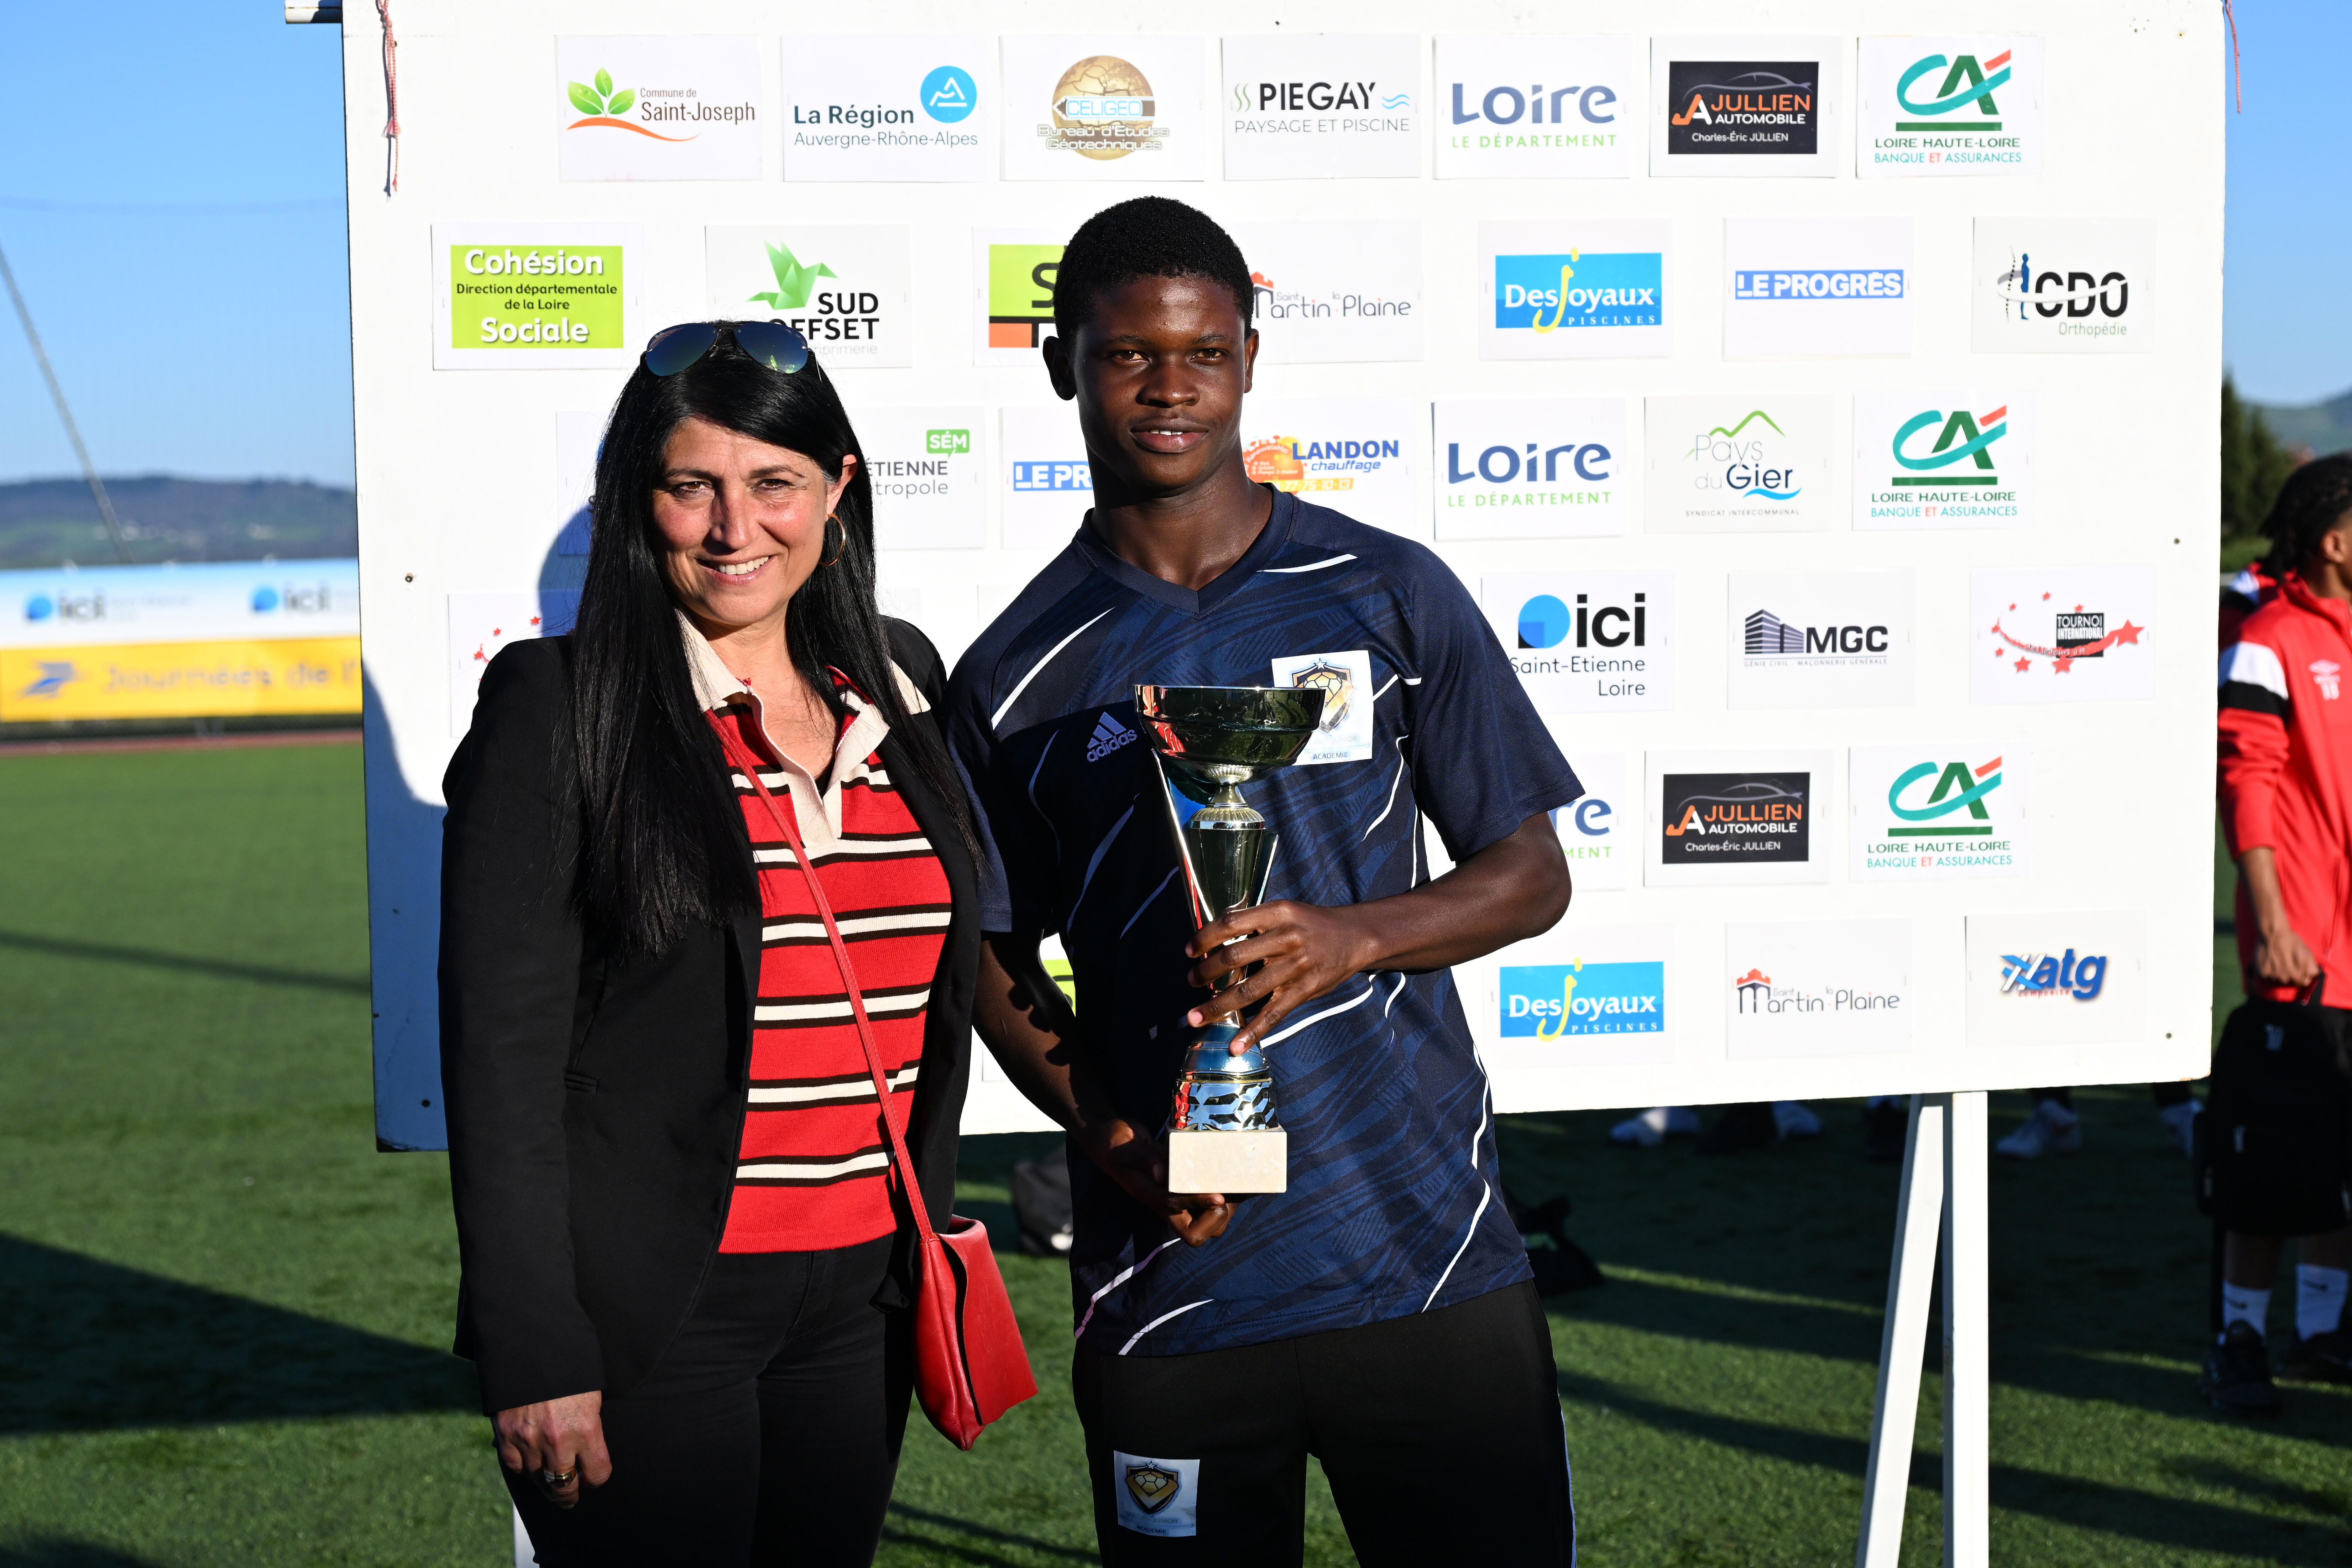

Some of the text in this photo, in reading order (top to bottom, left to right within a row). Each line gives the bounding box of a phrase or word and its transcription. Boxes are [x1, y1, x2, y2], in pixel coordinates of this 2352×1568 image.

[640, 87, 697, 98] Commune de
[1260, 82, 1376, 111] PIEGAY
[1067, 100, 1142, 116] CELIGEO
[1452, 83, 1617, 125] Loire
[1711, 94, 1810, 111] JULLIEN
[641, 102, 756, 125] Saint-Joseph
[794, 104, 914, 129] La Région
[1715, 114, 1806, 124] AUTOMOBILE
[1037, 124, 1097, 137] Bureau
[1235, 118, 1410, 133] PAYSAGE ET PISCINE
[794, 131, 978, 149] Auvergne-Rhône-Alpes
[1046, 137, 1162, 152] Géotechniques
[1452, 132, 1617, 148] LE DÉPARTEMENT
[1692, 130, 1788, 142] Charles-Éric JULLIEN
[1875, 138, 2020, 148] LOIRE HAUTE-LOIRE
[1875, 152, 2022, 163] BANQUE ET ASSURANCES
[465, 249, 603, 275] Cohésion
[456, 283, 617, 296] Direction départementale
[1738, 272, 1901, 297] LE PROGRÈS
[2035, 271, 2128, 318] CDO
[504, 299, 570, 309] de la Loire
[817, 292, 878, 315] SUD
[1343, 295, 1411, 317] Plaine
[1568, 314, 1656, 325] PISCINES
[480, 317, 589, 343] Sociale
[769, 318, 879, 340] FFSET
[2059, 322, 2127, 339] Orthopédie
[930, 431, 966, 448] SÉM
[1292, 440, 1399, 460] LANDON
[1694, 435, 1763, 469] Pays
[1311, 460, 1381, 472] chauffage
[1448, 443, 1611, 484] Loire
[1016, 465, 1049, 488] LE
[1694, 465, 1794, 490] du Gier
[874, 479, 948, 499] tropole
[1872, 492, 2016, 502] LOIRE HAUTE-LOIRE
[1448, 491, 1611, 507] LE DÉPARTEMENT
[1871, 506, 2018, 517] BANQUE ET ASSURANCES
[1577, 593, 1646, 648] ici
[2058, 615, 2102, 627] TOURNOI
[1806, 626, 1888, 654] MGC
[2058, 627, 2103, 640] INTERNATIONAL
[1510, 655, 1646, 674] Saint-Etienne
[1599, 679, 1645, 696] Loire
[1086, 730, 1137, 763] adidas
[1704, 804, 1802, 822] JULLIEN
[1708, 822, 1798, 834] AUTOMOBILE
[1685, 840, 1781, 852] Charles-Éric JULLIEN
[1868, 841, 2010, 853] LOIRE HAUTE-LOIRE
[1867, 855, 2012, 868] BANQUE ET ASSURANCES
[1836, 989, 1900, 1010] Plaine
[1571, 1021, 1659, 1035] PISCINES
[1137, 1525, 1166, 1534] ACADEMIE
